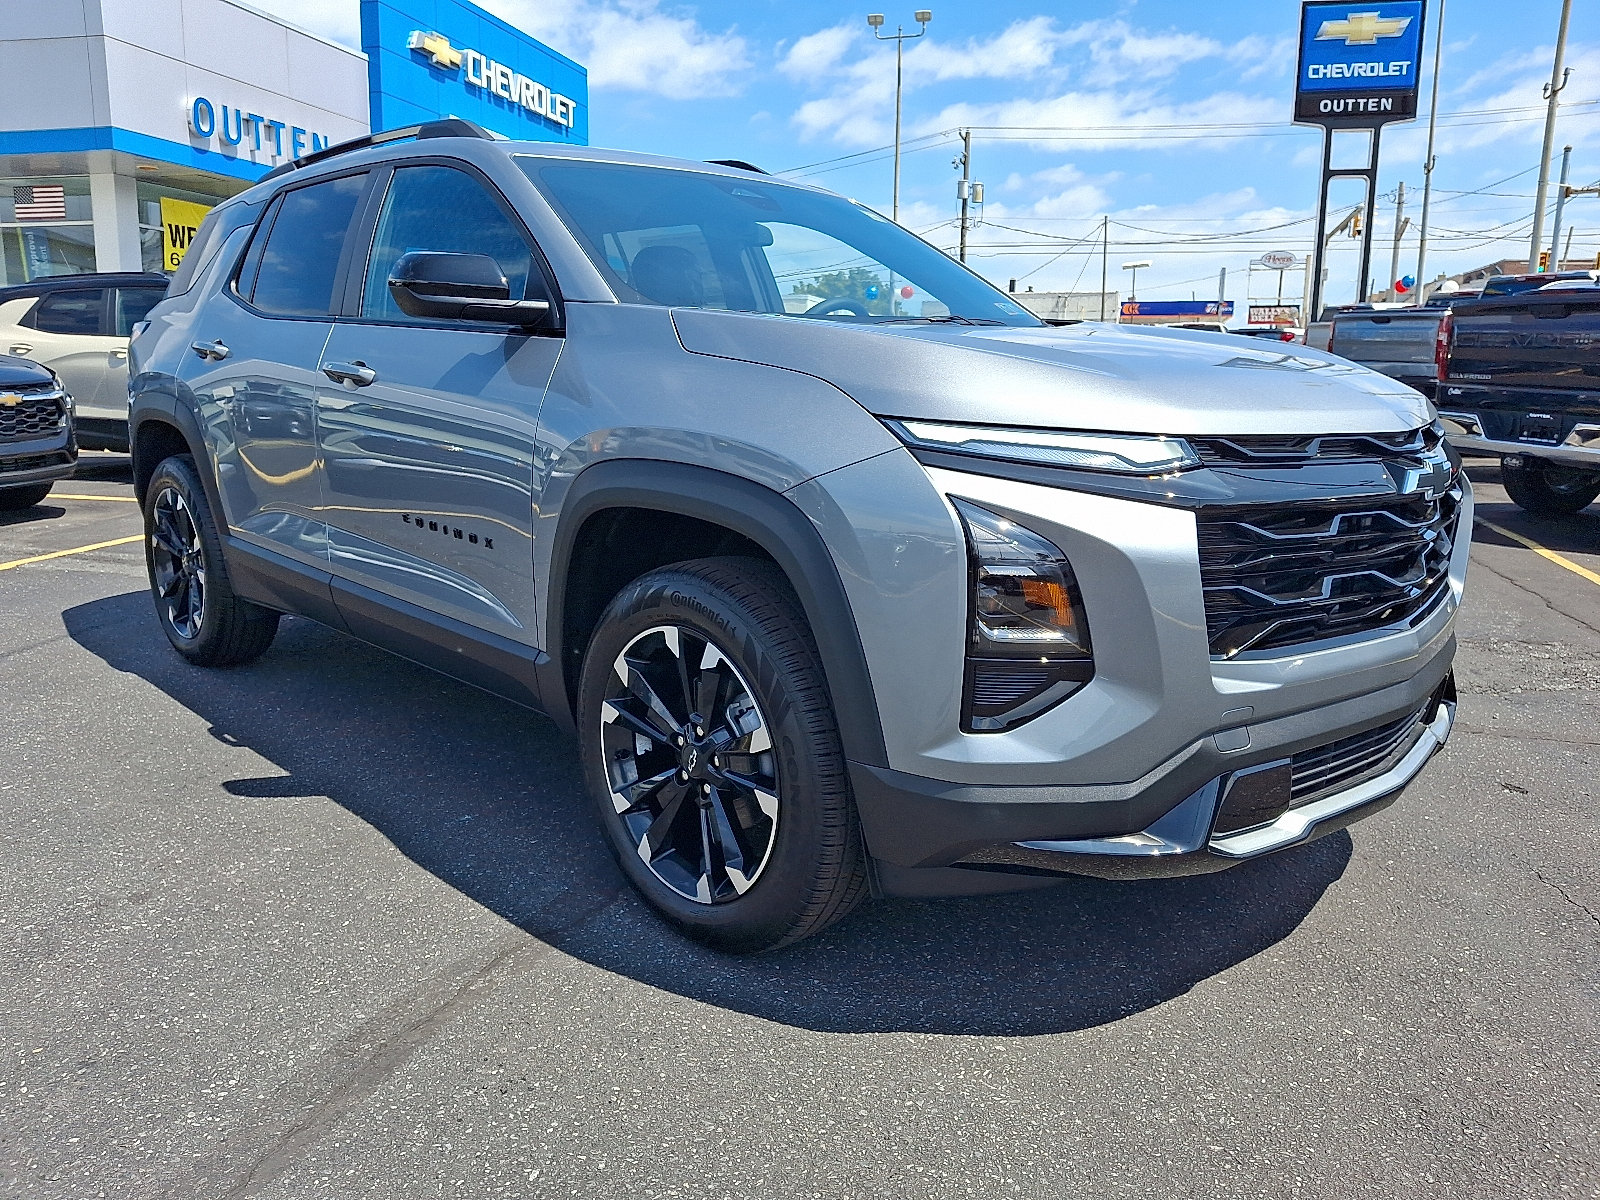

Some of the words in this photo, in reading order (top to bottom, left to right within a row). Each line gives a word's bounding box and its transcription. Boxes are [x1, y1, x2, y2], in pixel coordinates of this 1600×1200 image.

[466, 49, 577, 129] CHEVROLET
[1308, 61, 1412, 79] CHEVROLET
[1320, 97, 1393, 113] OUTTEN
[191, 97, 329, 159] OUTTEN
[25, 231, 40, 271] Approval
[402, 513, 494, 550] EQUINOX
[670, 590, 731, 634] Continental
